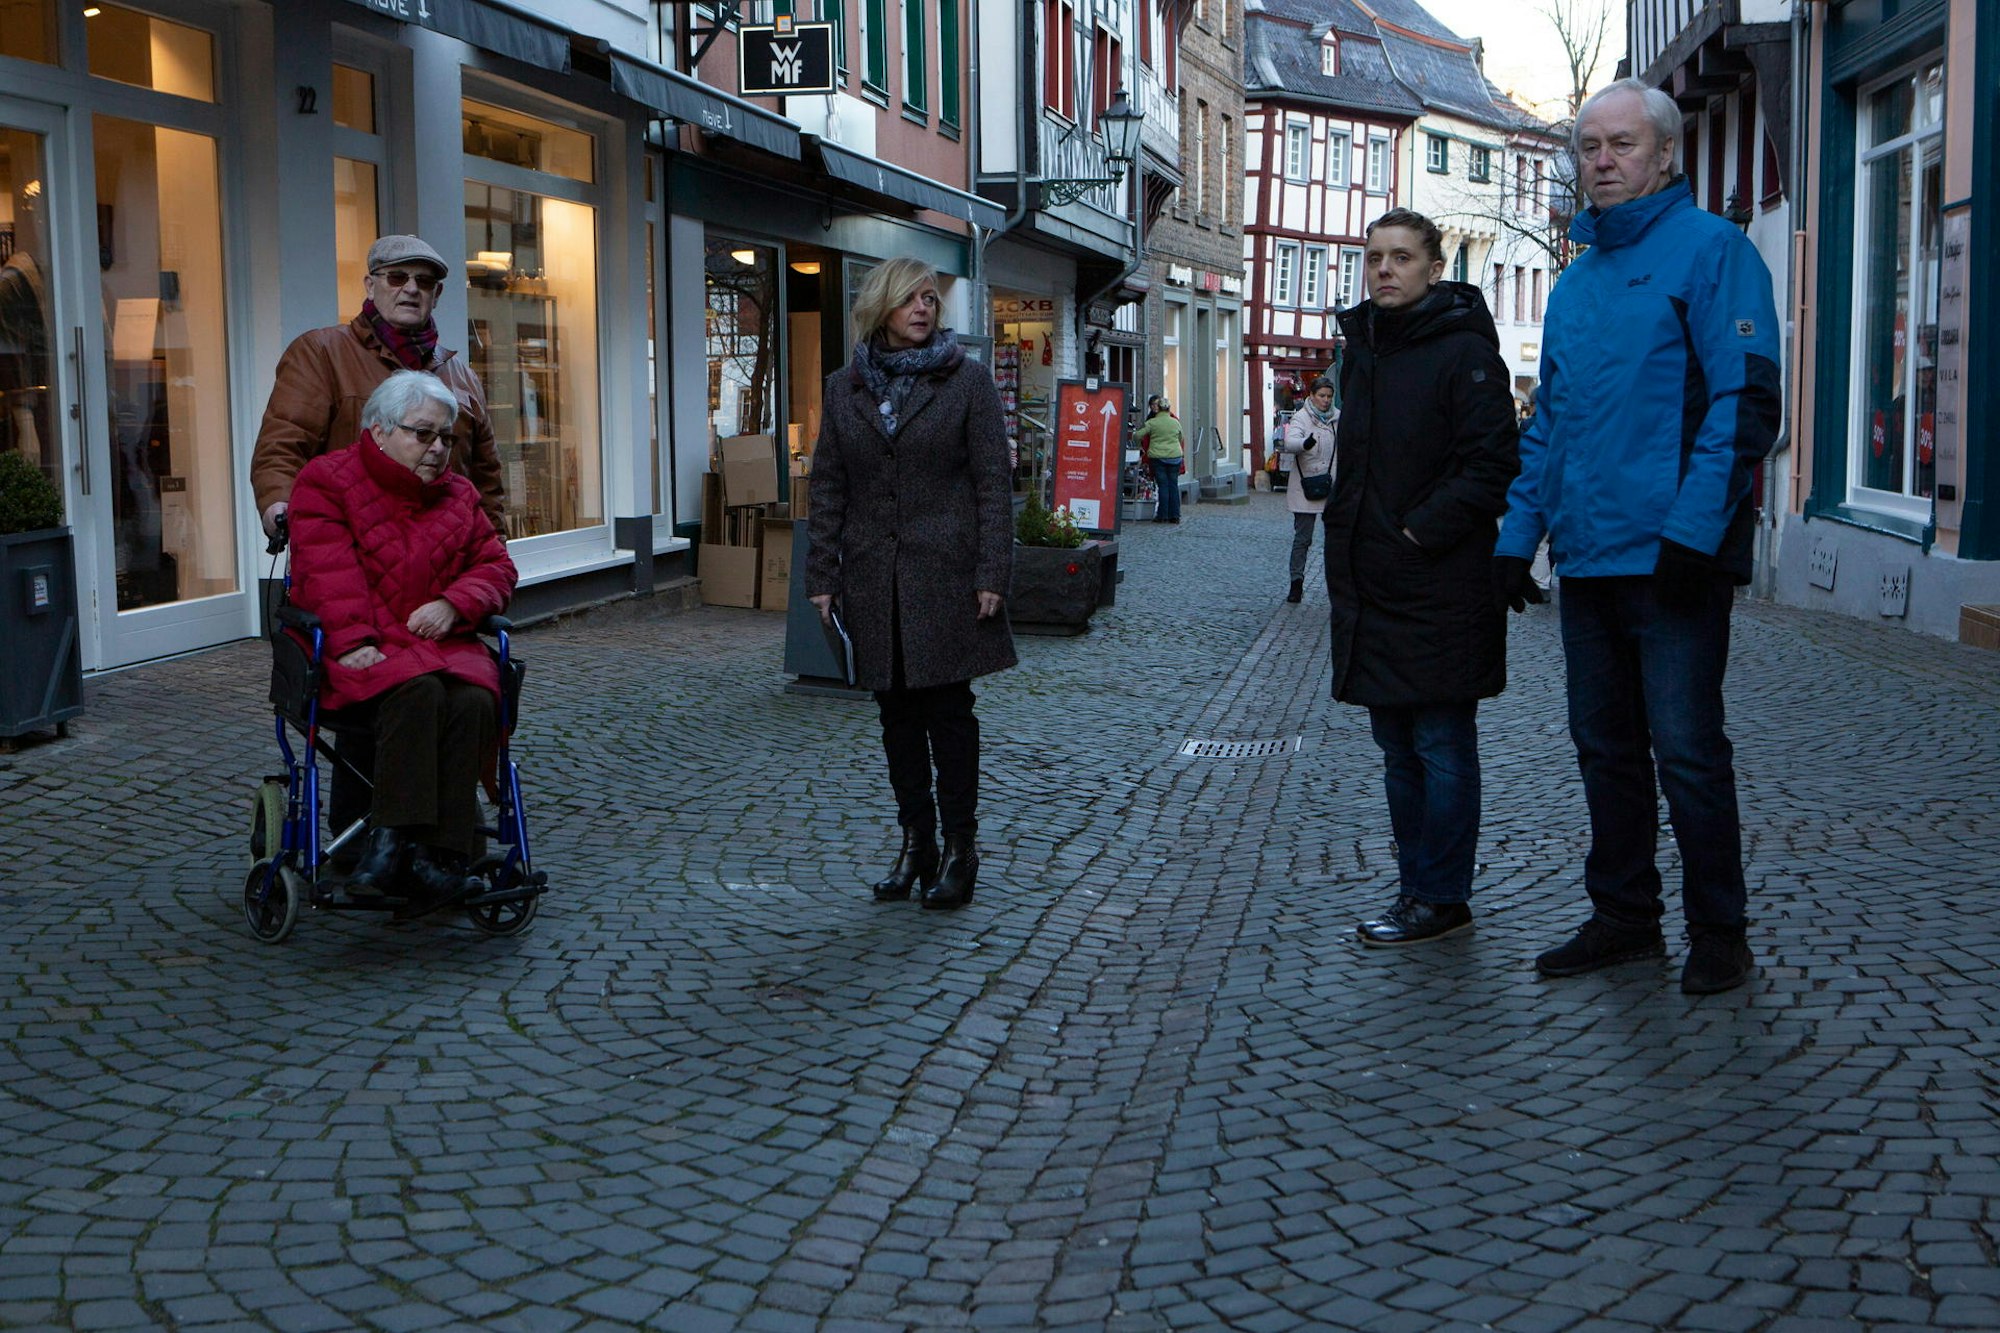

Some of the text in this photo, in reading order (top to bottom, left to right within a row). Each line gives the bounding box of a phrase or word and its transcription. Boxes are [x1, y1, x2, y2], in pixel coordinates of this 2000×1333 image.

[295, 86, 318, 114] 22
[1940, 369, 1958, 381] VILA
[1920, 428, 1934, 449] 30%
